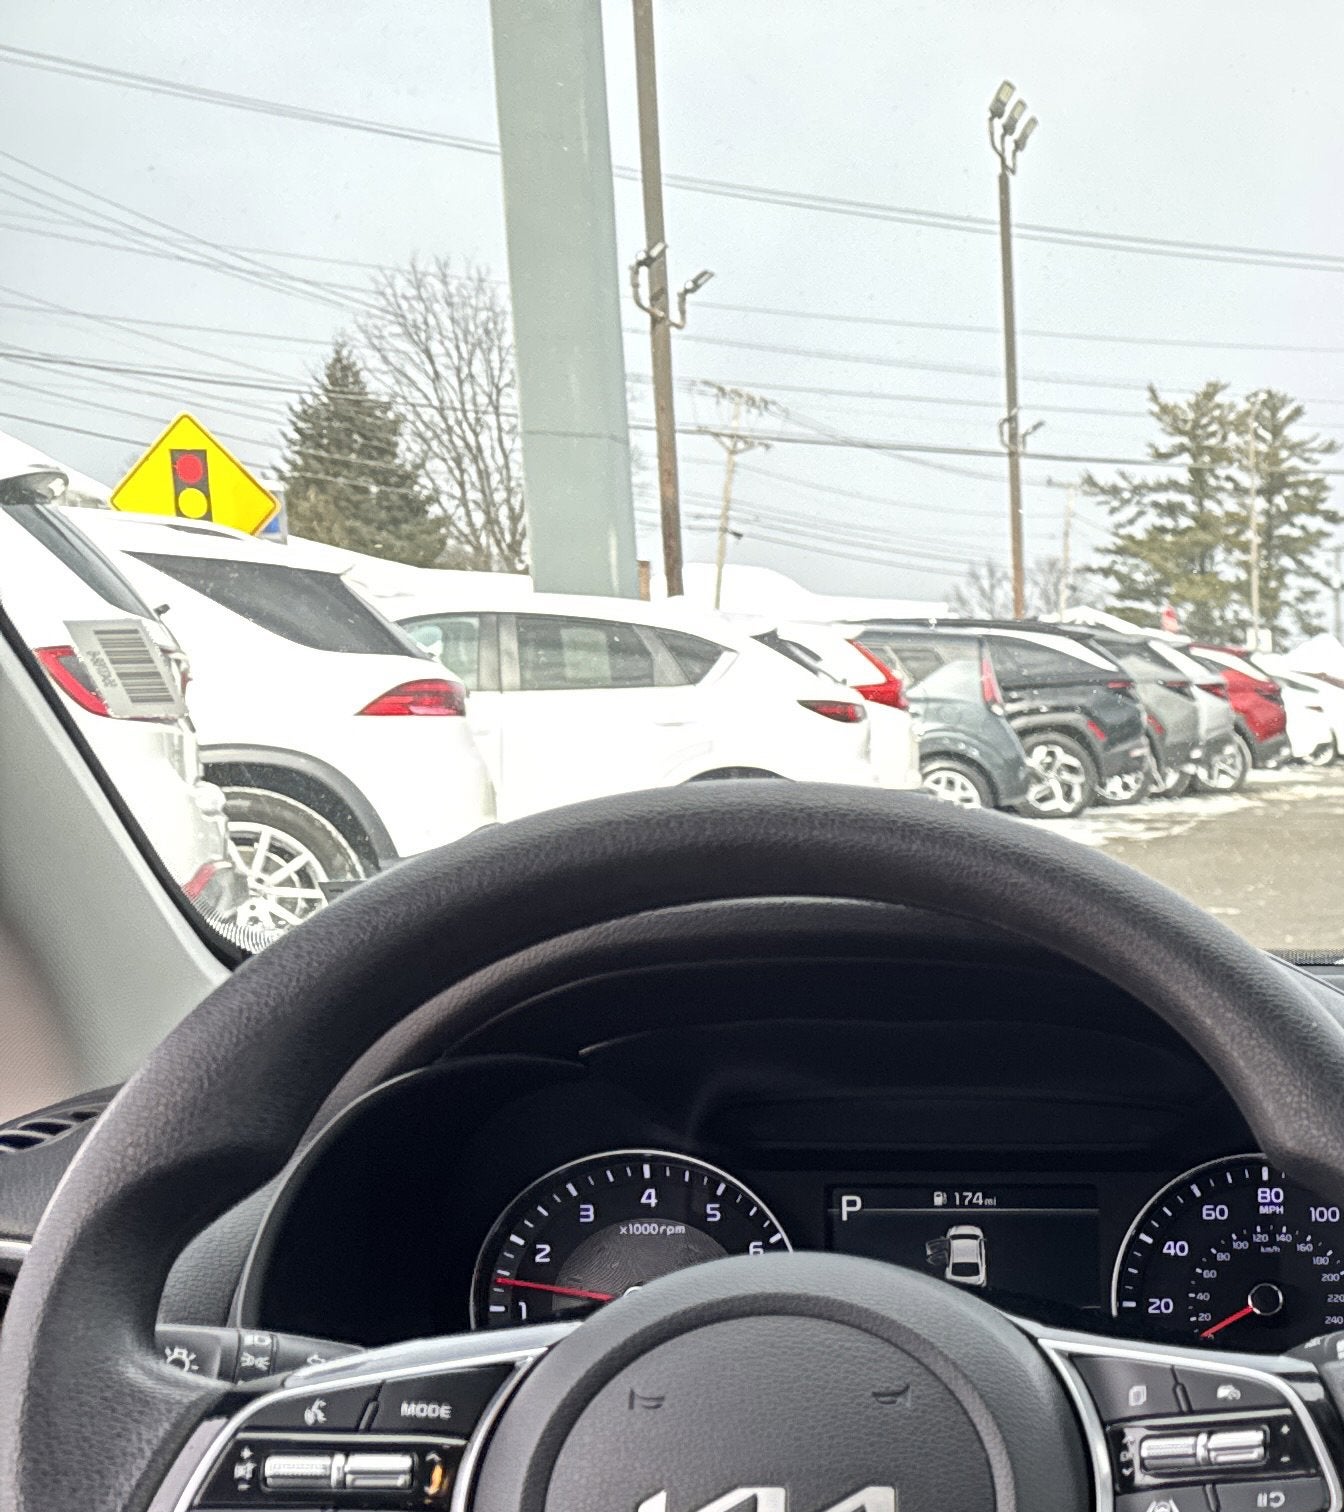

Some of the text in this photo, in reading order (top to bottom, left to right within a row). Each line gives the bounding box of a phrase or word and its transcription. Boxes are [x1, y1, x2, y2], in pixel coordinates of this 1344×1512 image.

[640, 1188, 658, 1208] 4
[954, 1191, 997, 1206] 174 mi
[1257, 1187, 1284, 1204] 80
[579, 1204, 595, 1223] 3
[706, 1203, 721, 1222] 5
[841, 1195, 862, 1221] P
[1202, 1204, 1229, 1221] 60
[1259, 1204, 1284, 1215] MPH
[1309, 1206, 1340, 1223] 100
[619, 1223, 686, 1236] x1000rpm
[1252, 1233, 1269, 1243] 120
[1275, 1233, 1293, 1243] 140
[1162, 1240, 1189, 1257] 40
[1232, 1240, 1249, 1250] 100
[1260, 1245, 1281, 1253] km/h
[1296, 1243, 1314, 1252] 160
[534, 1244, 551, 1263] 2
[1216, 1252, 1231, 1262] 80
[1312, 1256, 1330, 1266] 180
[1202, 1269, 1217, 1279] 60
[1321, 1272, 1340, 1282] 200
[1196, 1292, 1211, 1301] 40
[518, 1301, 527, 1320] 1
[1147, 1298, 1174, 1314] 20
[1197, 1312, 1212, 1322] 20
[1324, 1315, 1344, 1325] 240
[400, 1401, 451, 1419] MODE
